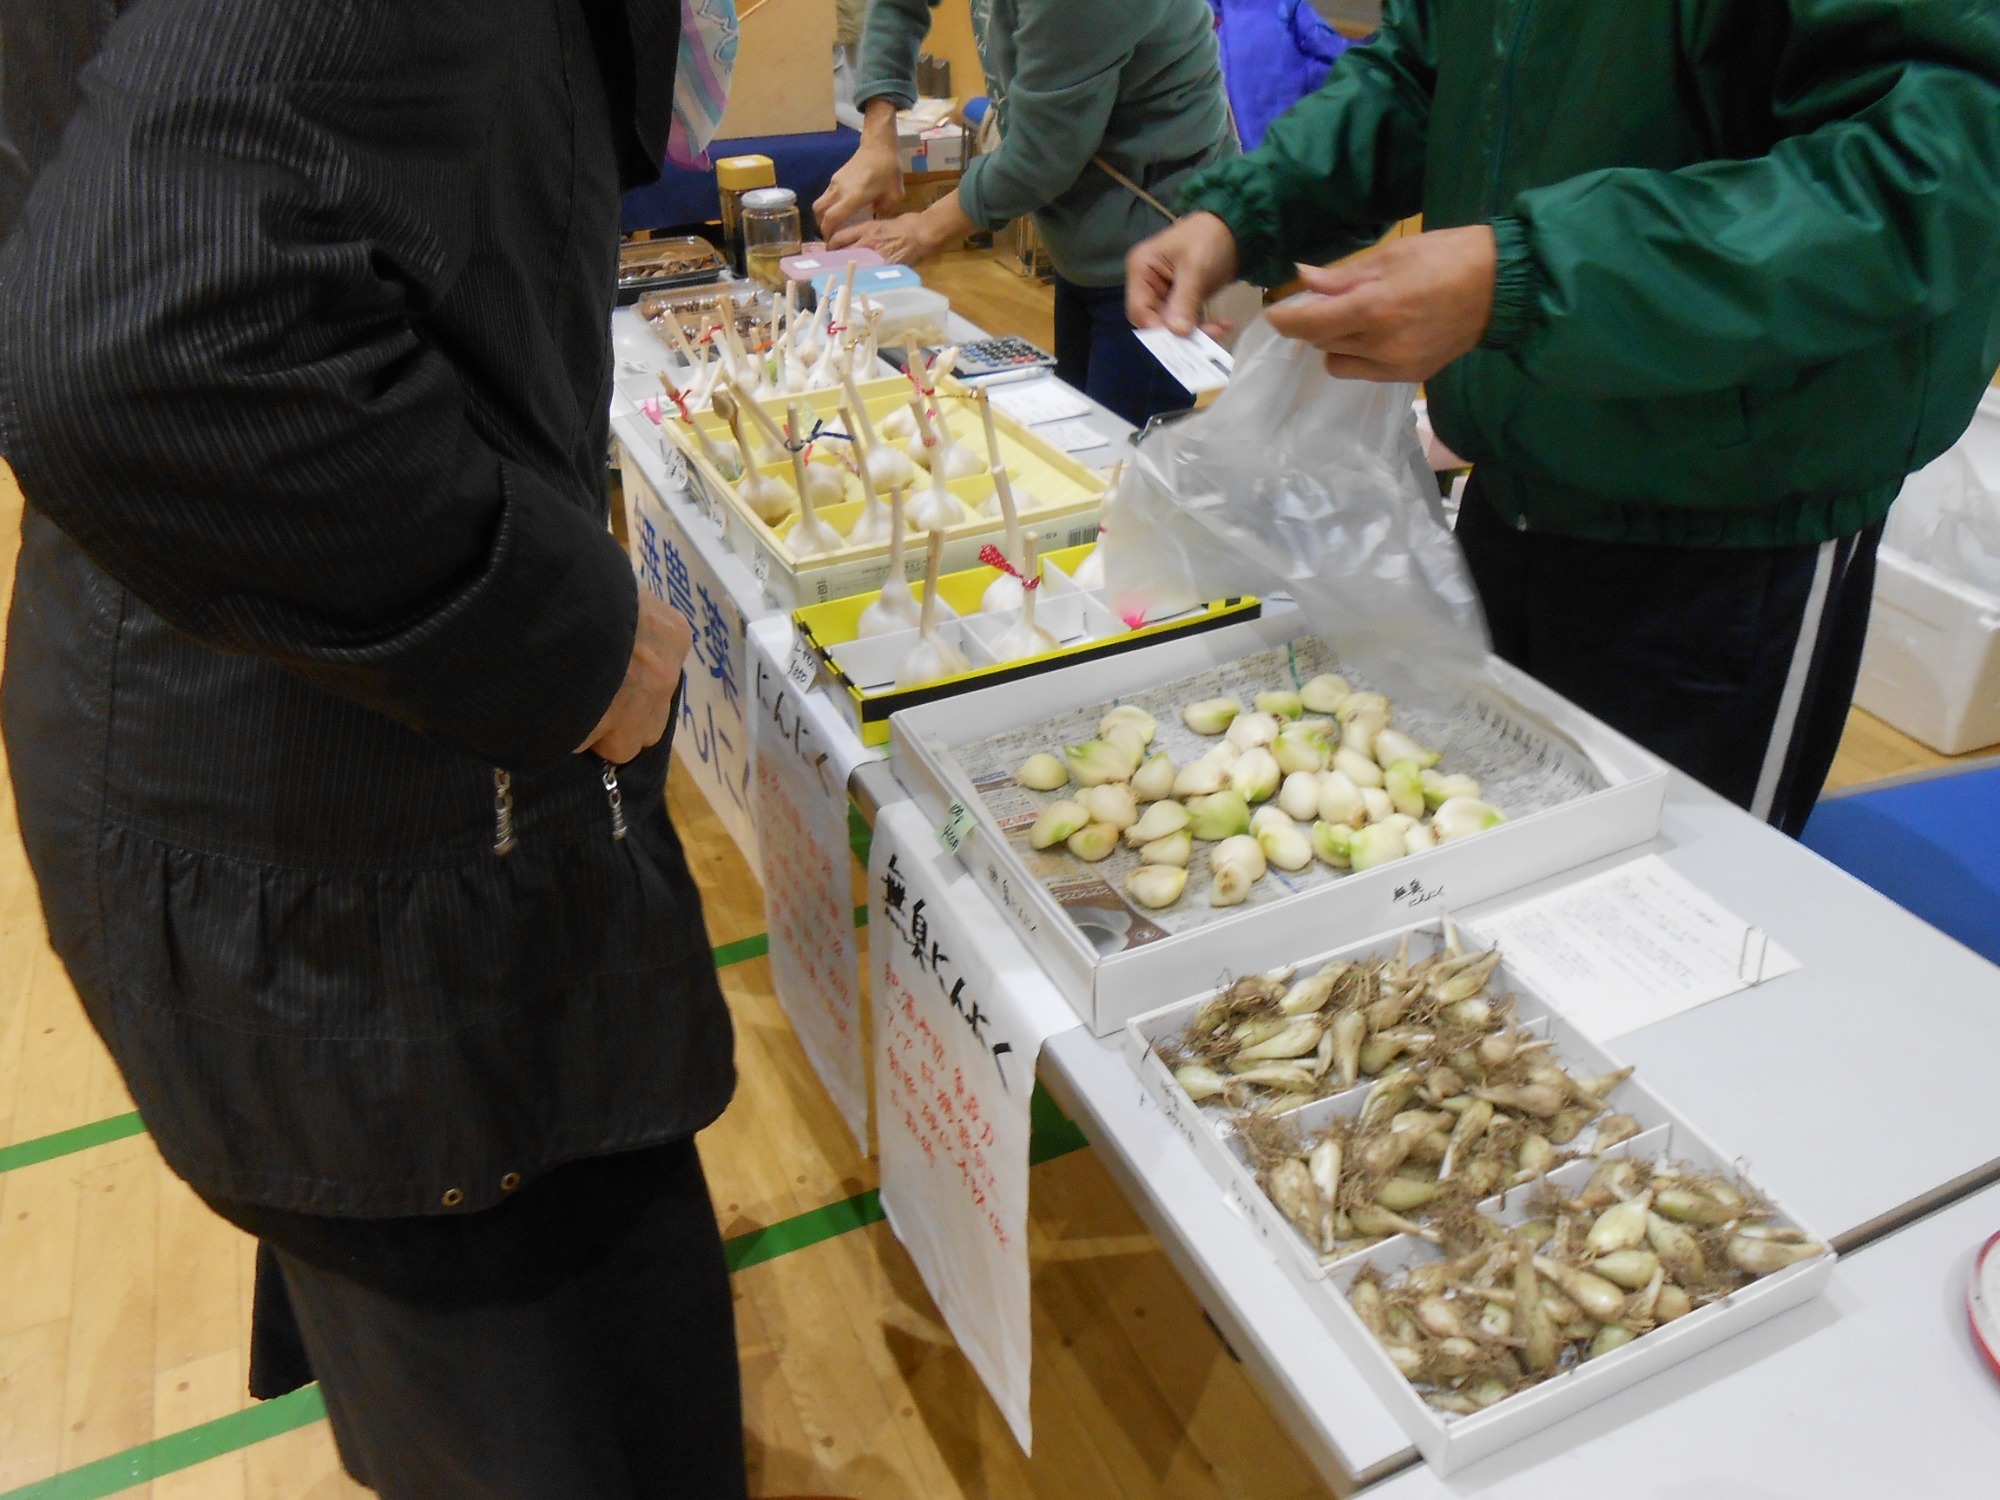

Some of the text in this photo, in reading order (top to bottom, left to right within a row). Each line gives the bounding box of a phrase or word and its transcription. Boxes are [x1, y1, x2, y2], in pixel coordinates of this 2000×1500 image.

[755, 661, 832, 797] にんにく
[880, 853, 1013, 1094] 無臭にんにく
